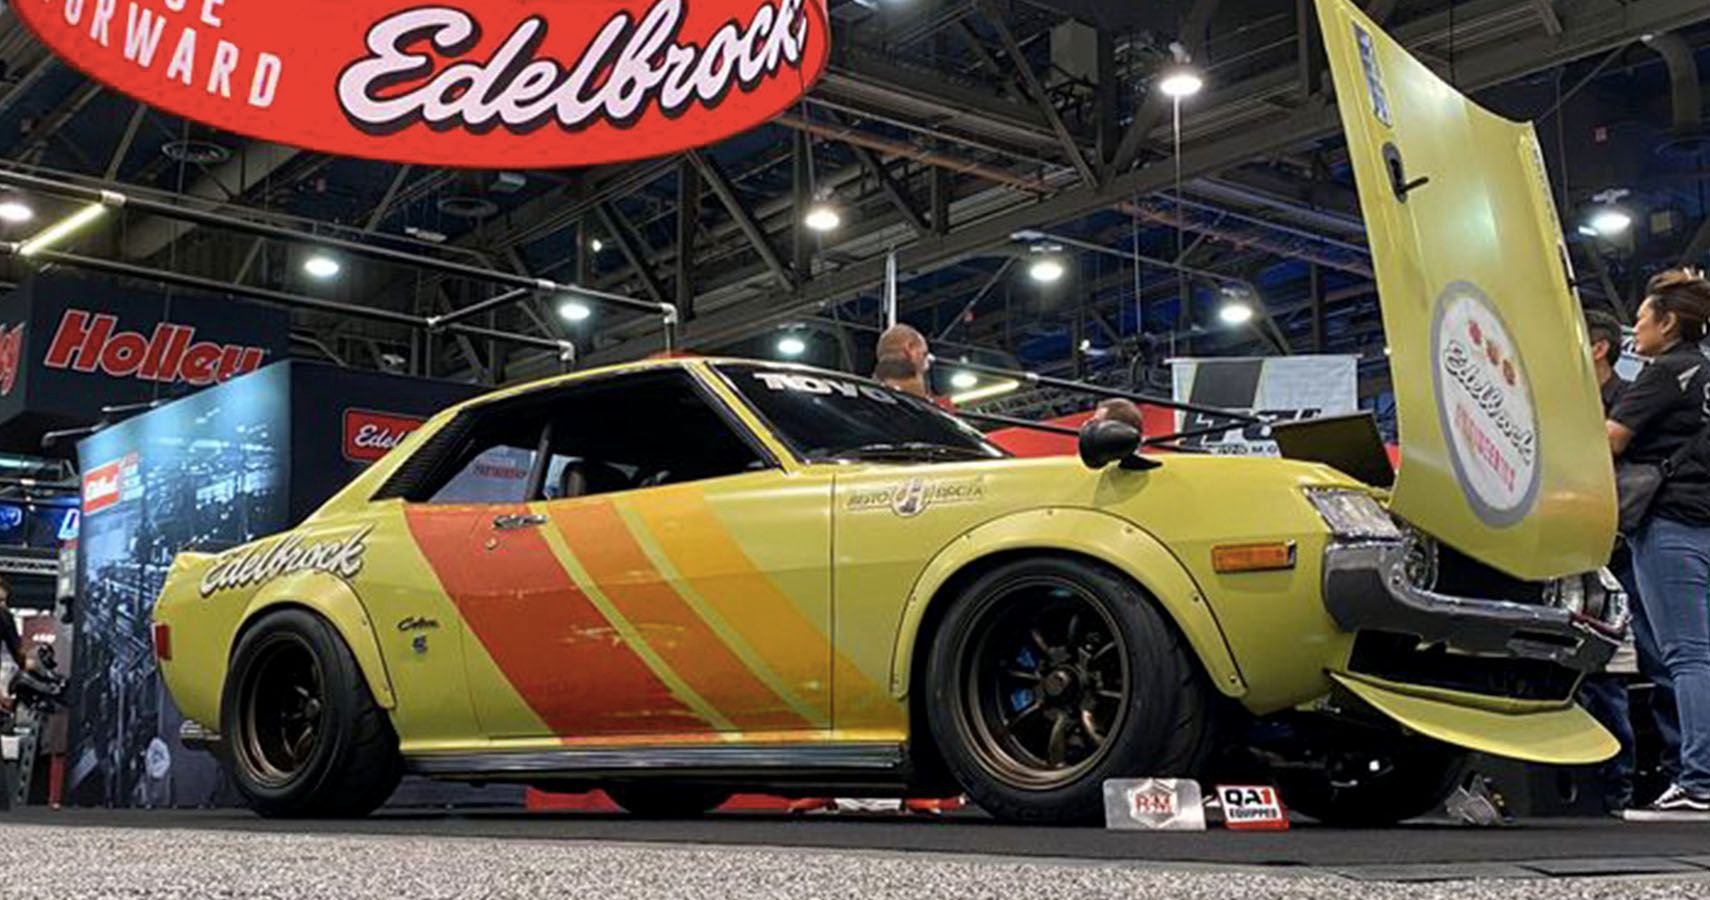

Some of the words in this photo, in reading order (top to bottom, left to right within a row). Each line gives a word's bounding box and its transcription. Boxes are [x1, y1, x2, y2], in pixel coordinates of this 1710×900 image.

[43, 0, 282, 108] ORWARD
[336, 0, 807, 134] Edelbrock
[354, 423, 406, 449] Edel
[200, 523, 376, 598] Edelbrock
[1224, 788, 1272, 806] QA1
